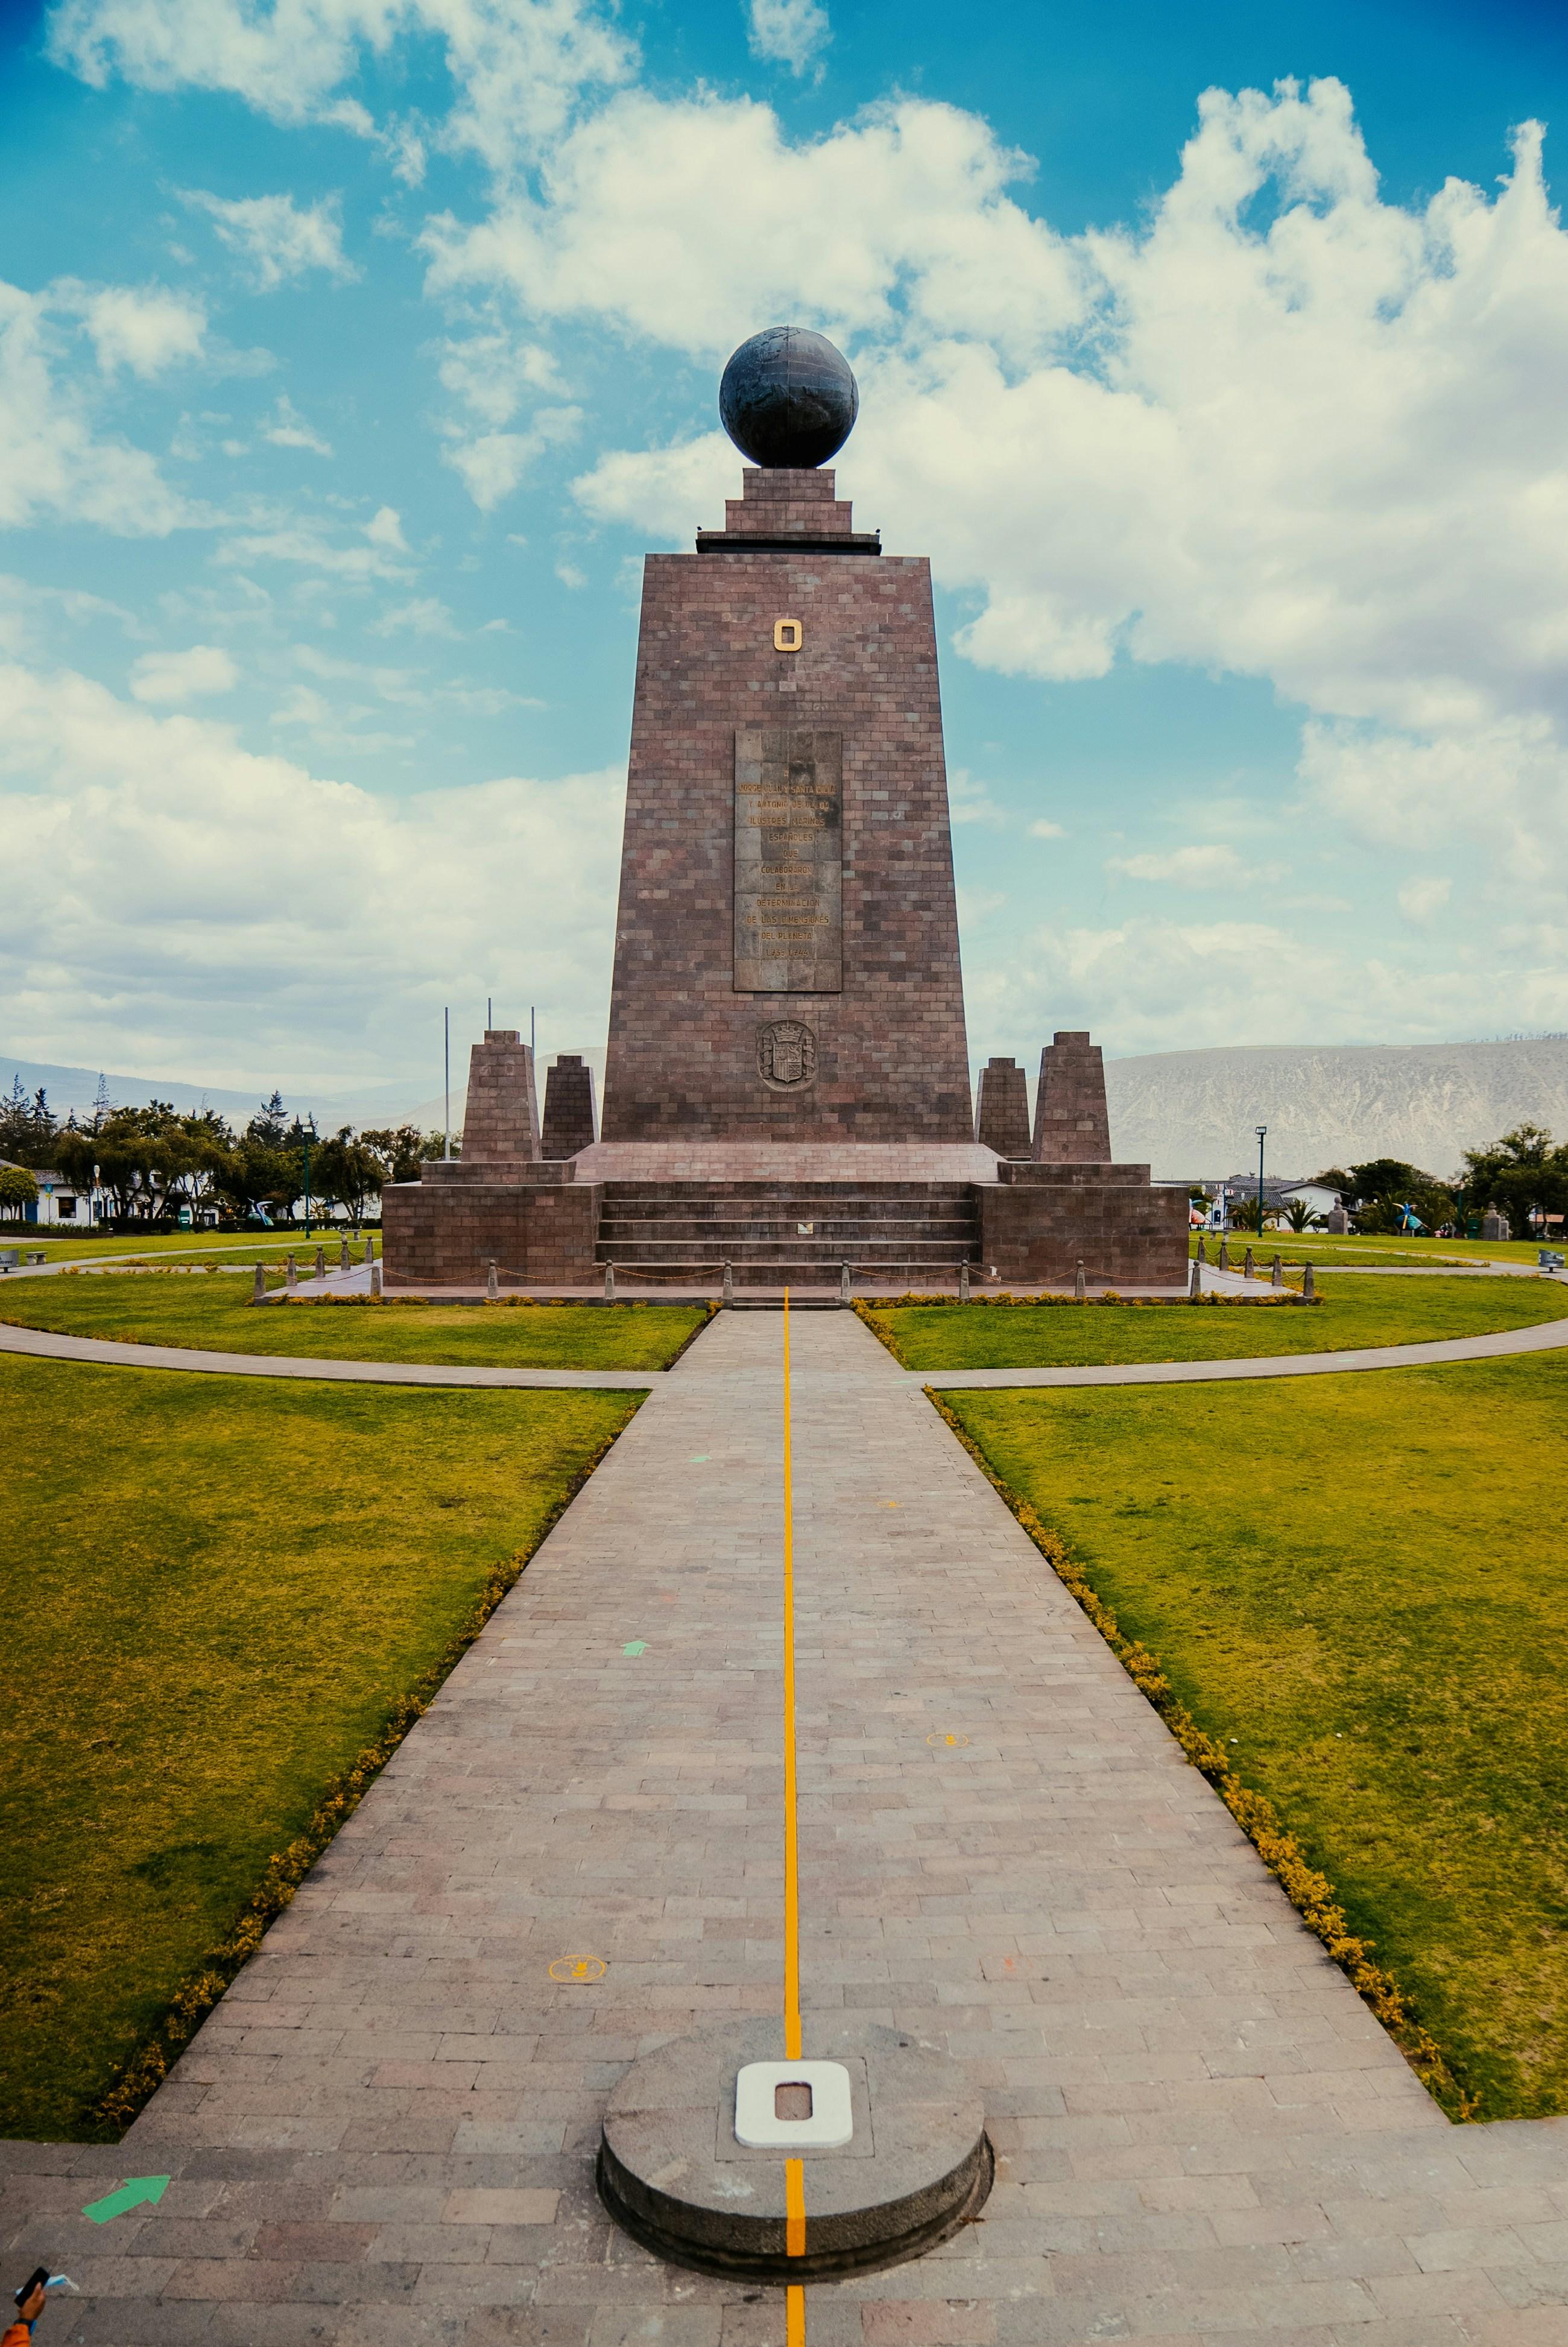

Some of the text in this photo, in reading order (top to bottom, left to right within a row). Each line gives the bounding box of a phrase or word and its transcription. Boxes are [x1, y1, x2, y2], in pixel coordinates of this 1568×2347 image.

[750, 817, 826, 826] ILUSTRES MARINOS
[783, 850, 798, 858] QUE
[760, 866, 812, 874] COLABORARON
[762, 932, 812, 940] DEL PLANETA
